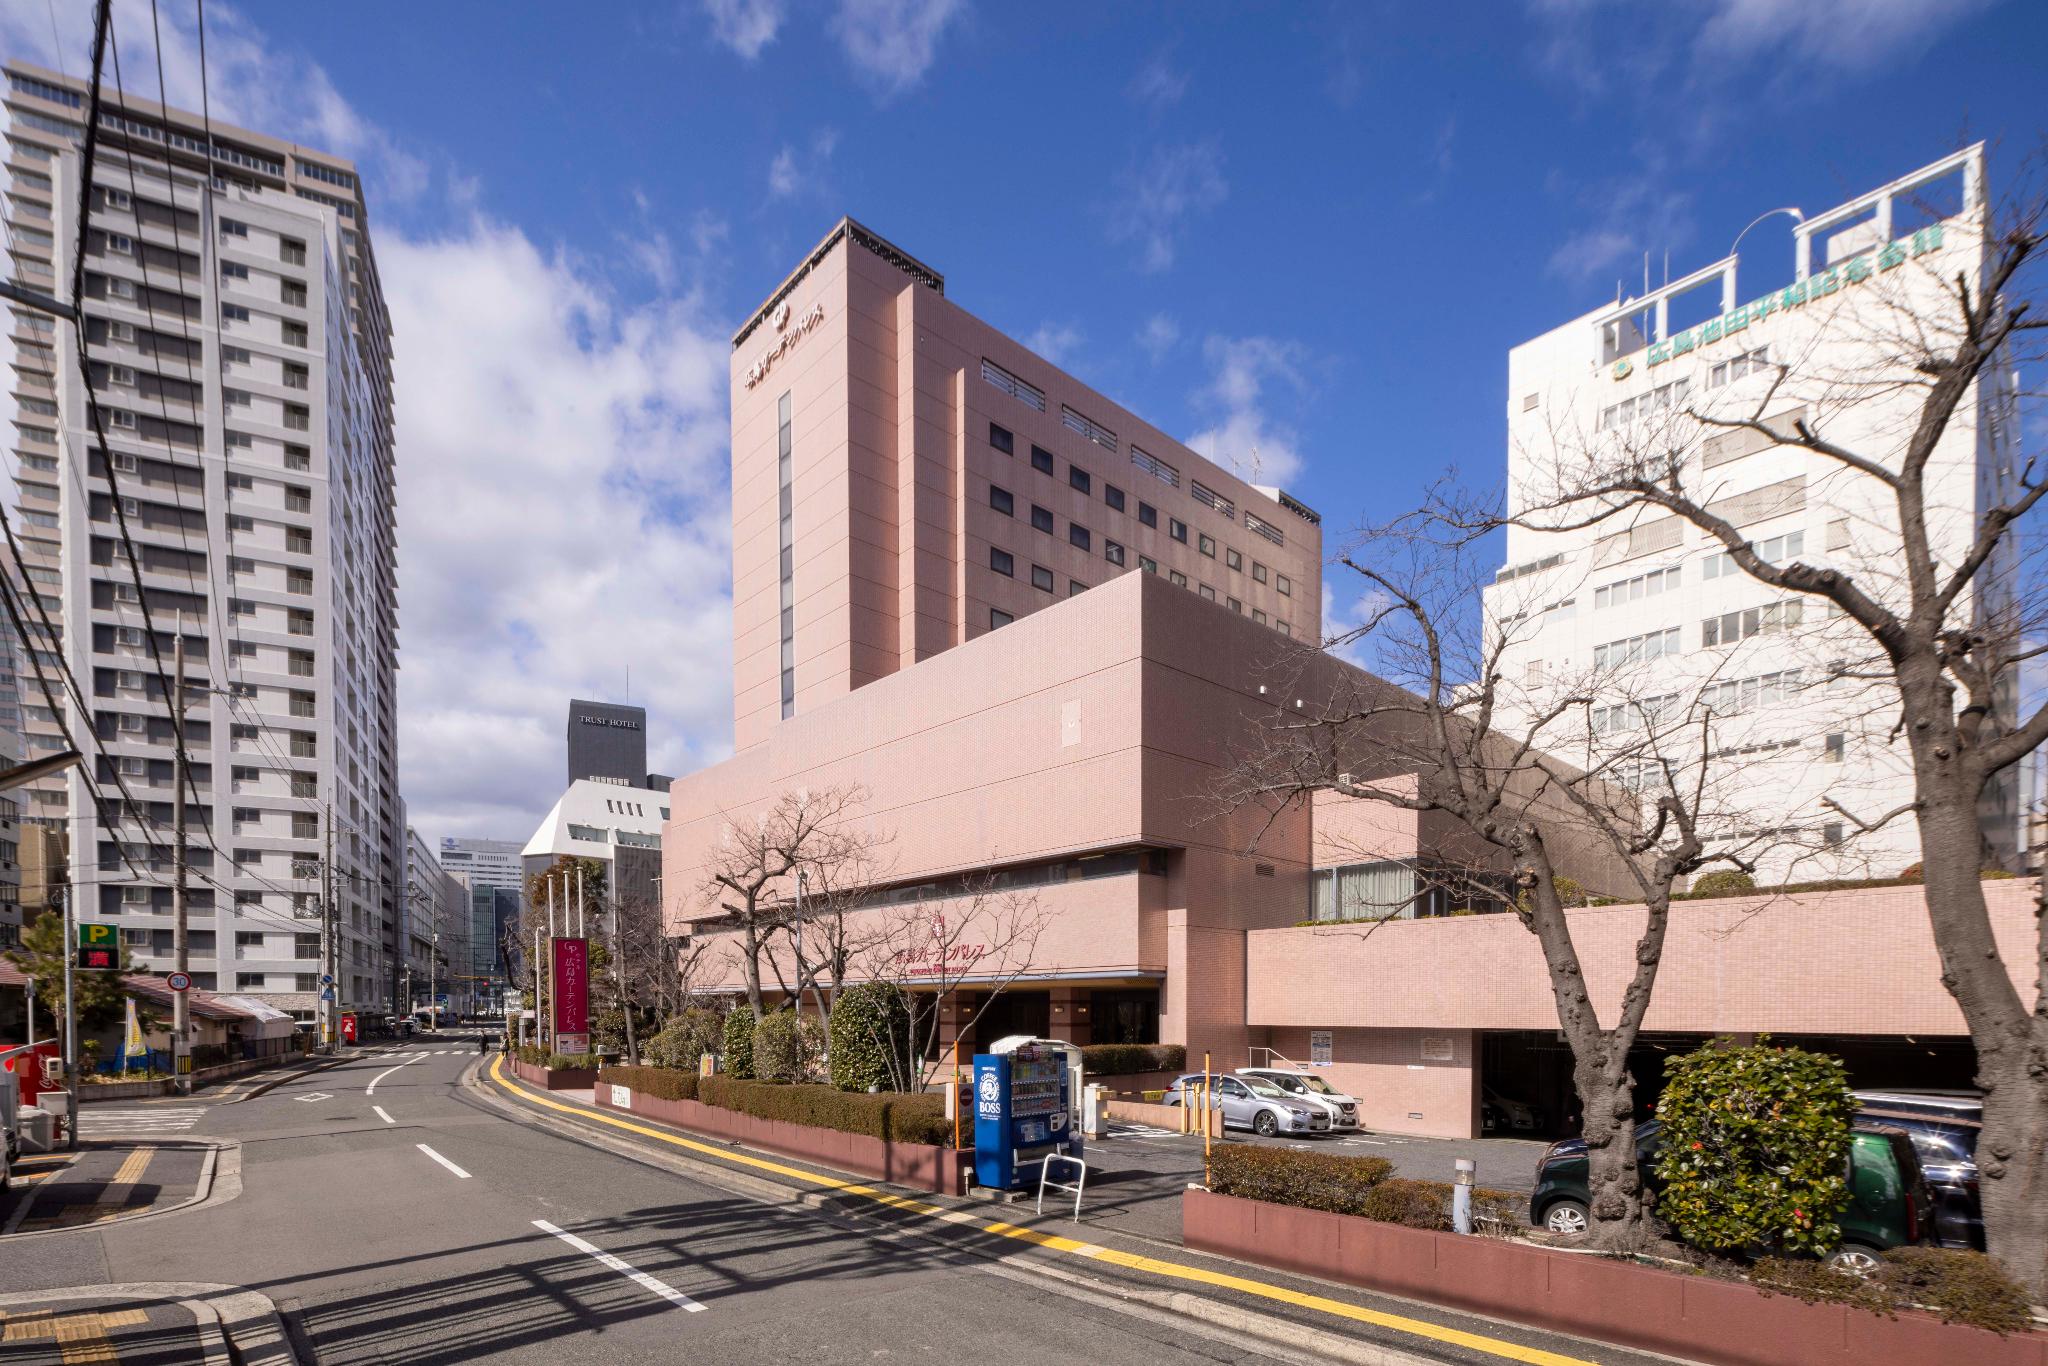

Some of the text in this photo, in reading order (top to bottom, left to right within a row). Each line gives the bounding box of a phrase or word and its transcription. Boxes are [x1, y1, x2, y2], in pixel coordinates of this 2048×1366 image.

[580, 715, 638, 728] TRUST HOTEL
[90, 925, 109, 942] P
[173, 977, 186, 986] 30
[979, 1102, 1001, 1114] BOSS
